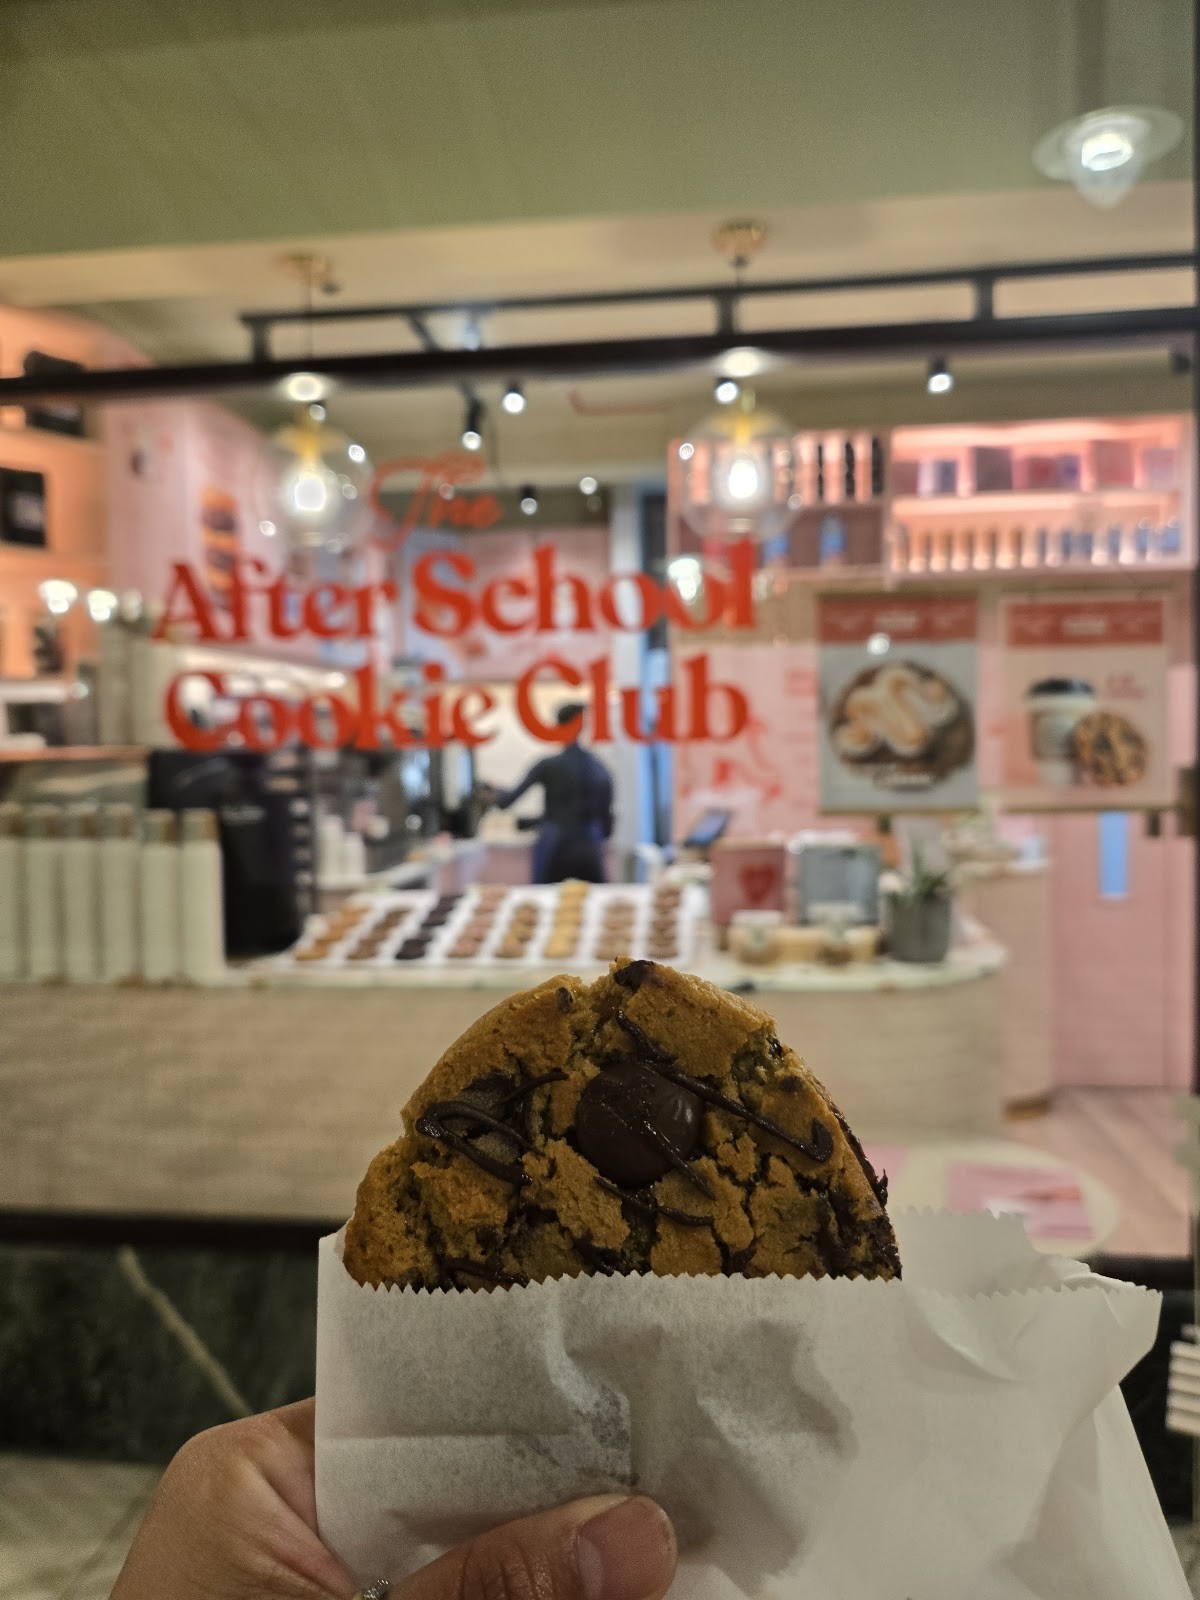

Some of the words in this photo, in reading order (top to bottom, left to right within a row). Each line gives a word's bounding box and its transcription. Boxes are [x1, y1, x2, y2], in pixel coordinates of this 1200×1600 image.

[370, 453, 502, 549] The
[152, 558, 396, 643] After
[412, 542, 756, 637] School
[165, 664, 495, 752] Cookie
[515, 655, 751, 745] Club
